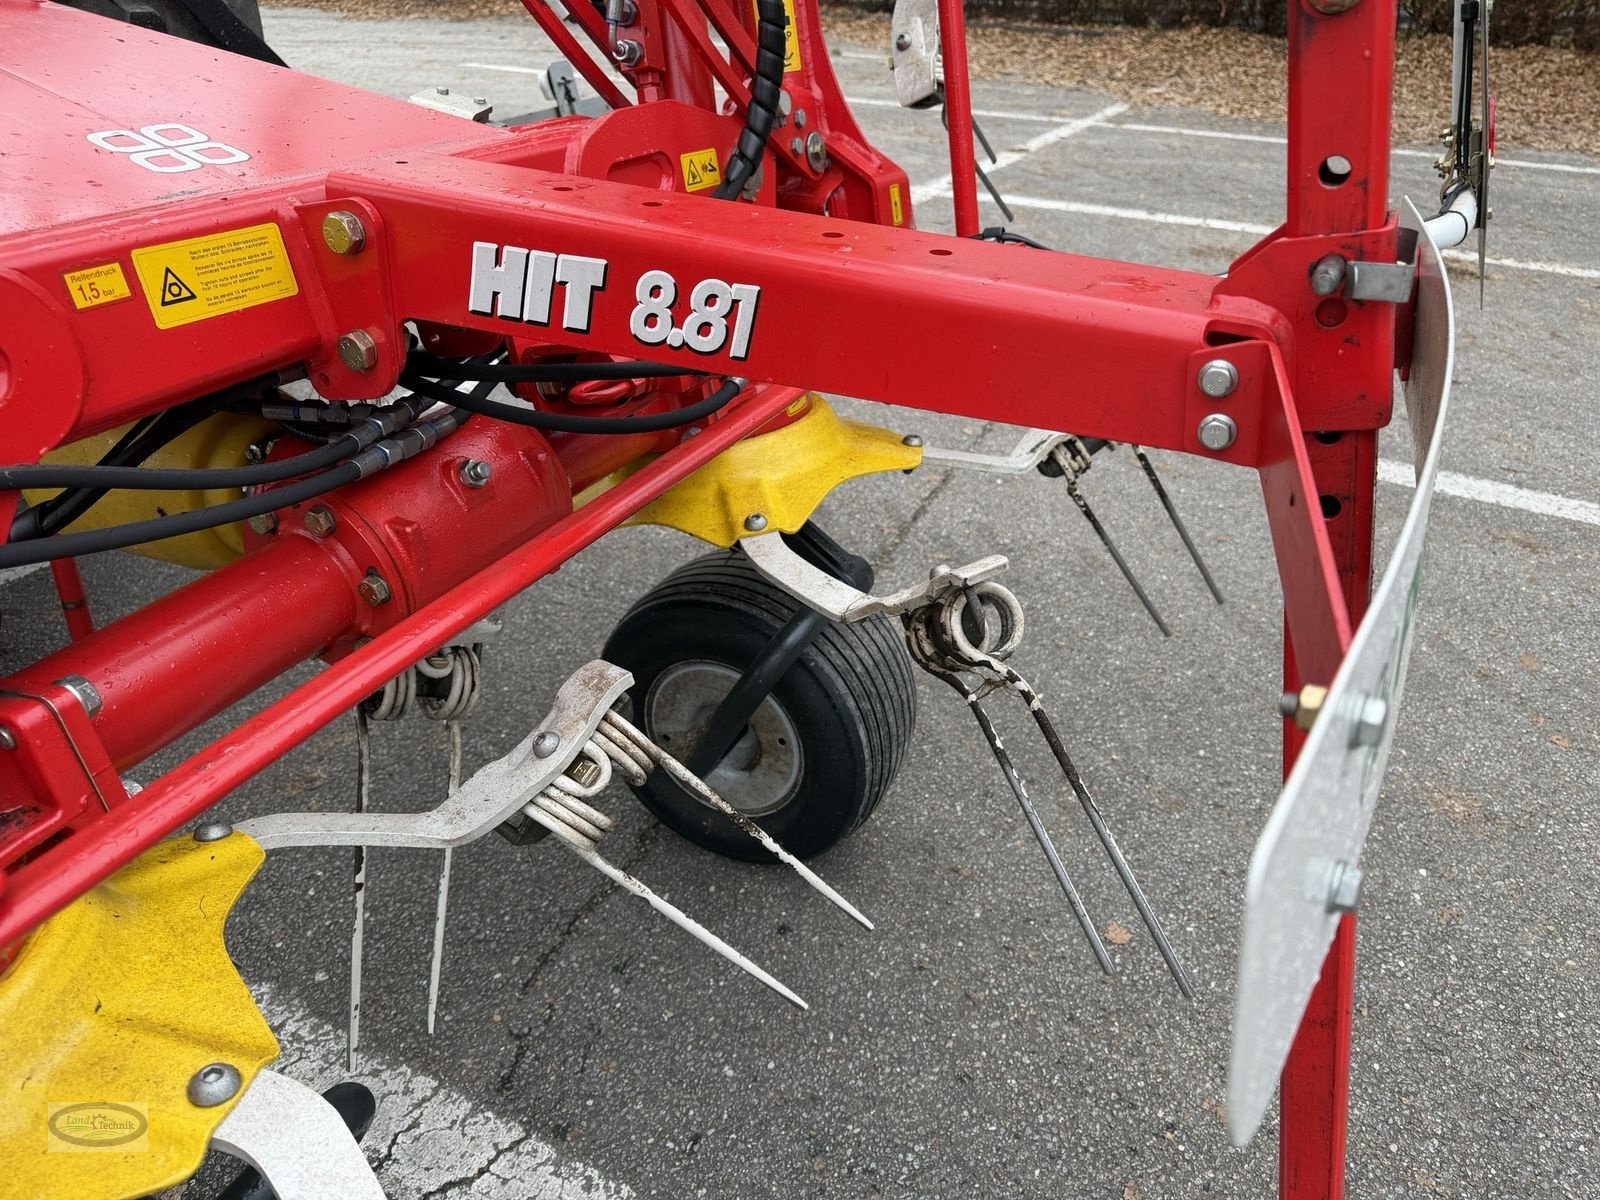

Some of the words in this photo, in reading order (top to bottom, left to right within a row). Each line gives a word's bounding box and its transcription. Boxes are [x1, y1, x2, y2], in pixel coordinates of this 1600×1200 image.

[70, 267, 117, 283] Reifendruck
[78, 282, 100, 304] 1,5
[102, 289, 115, 297] bar
[469, 241, 608, 334] HIT
[630, 270, 761, 360] 8.81
